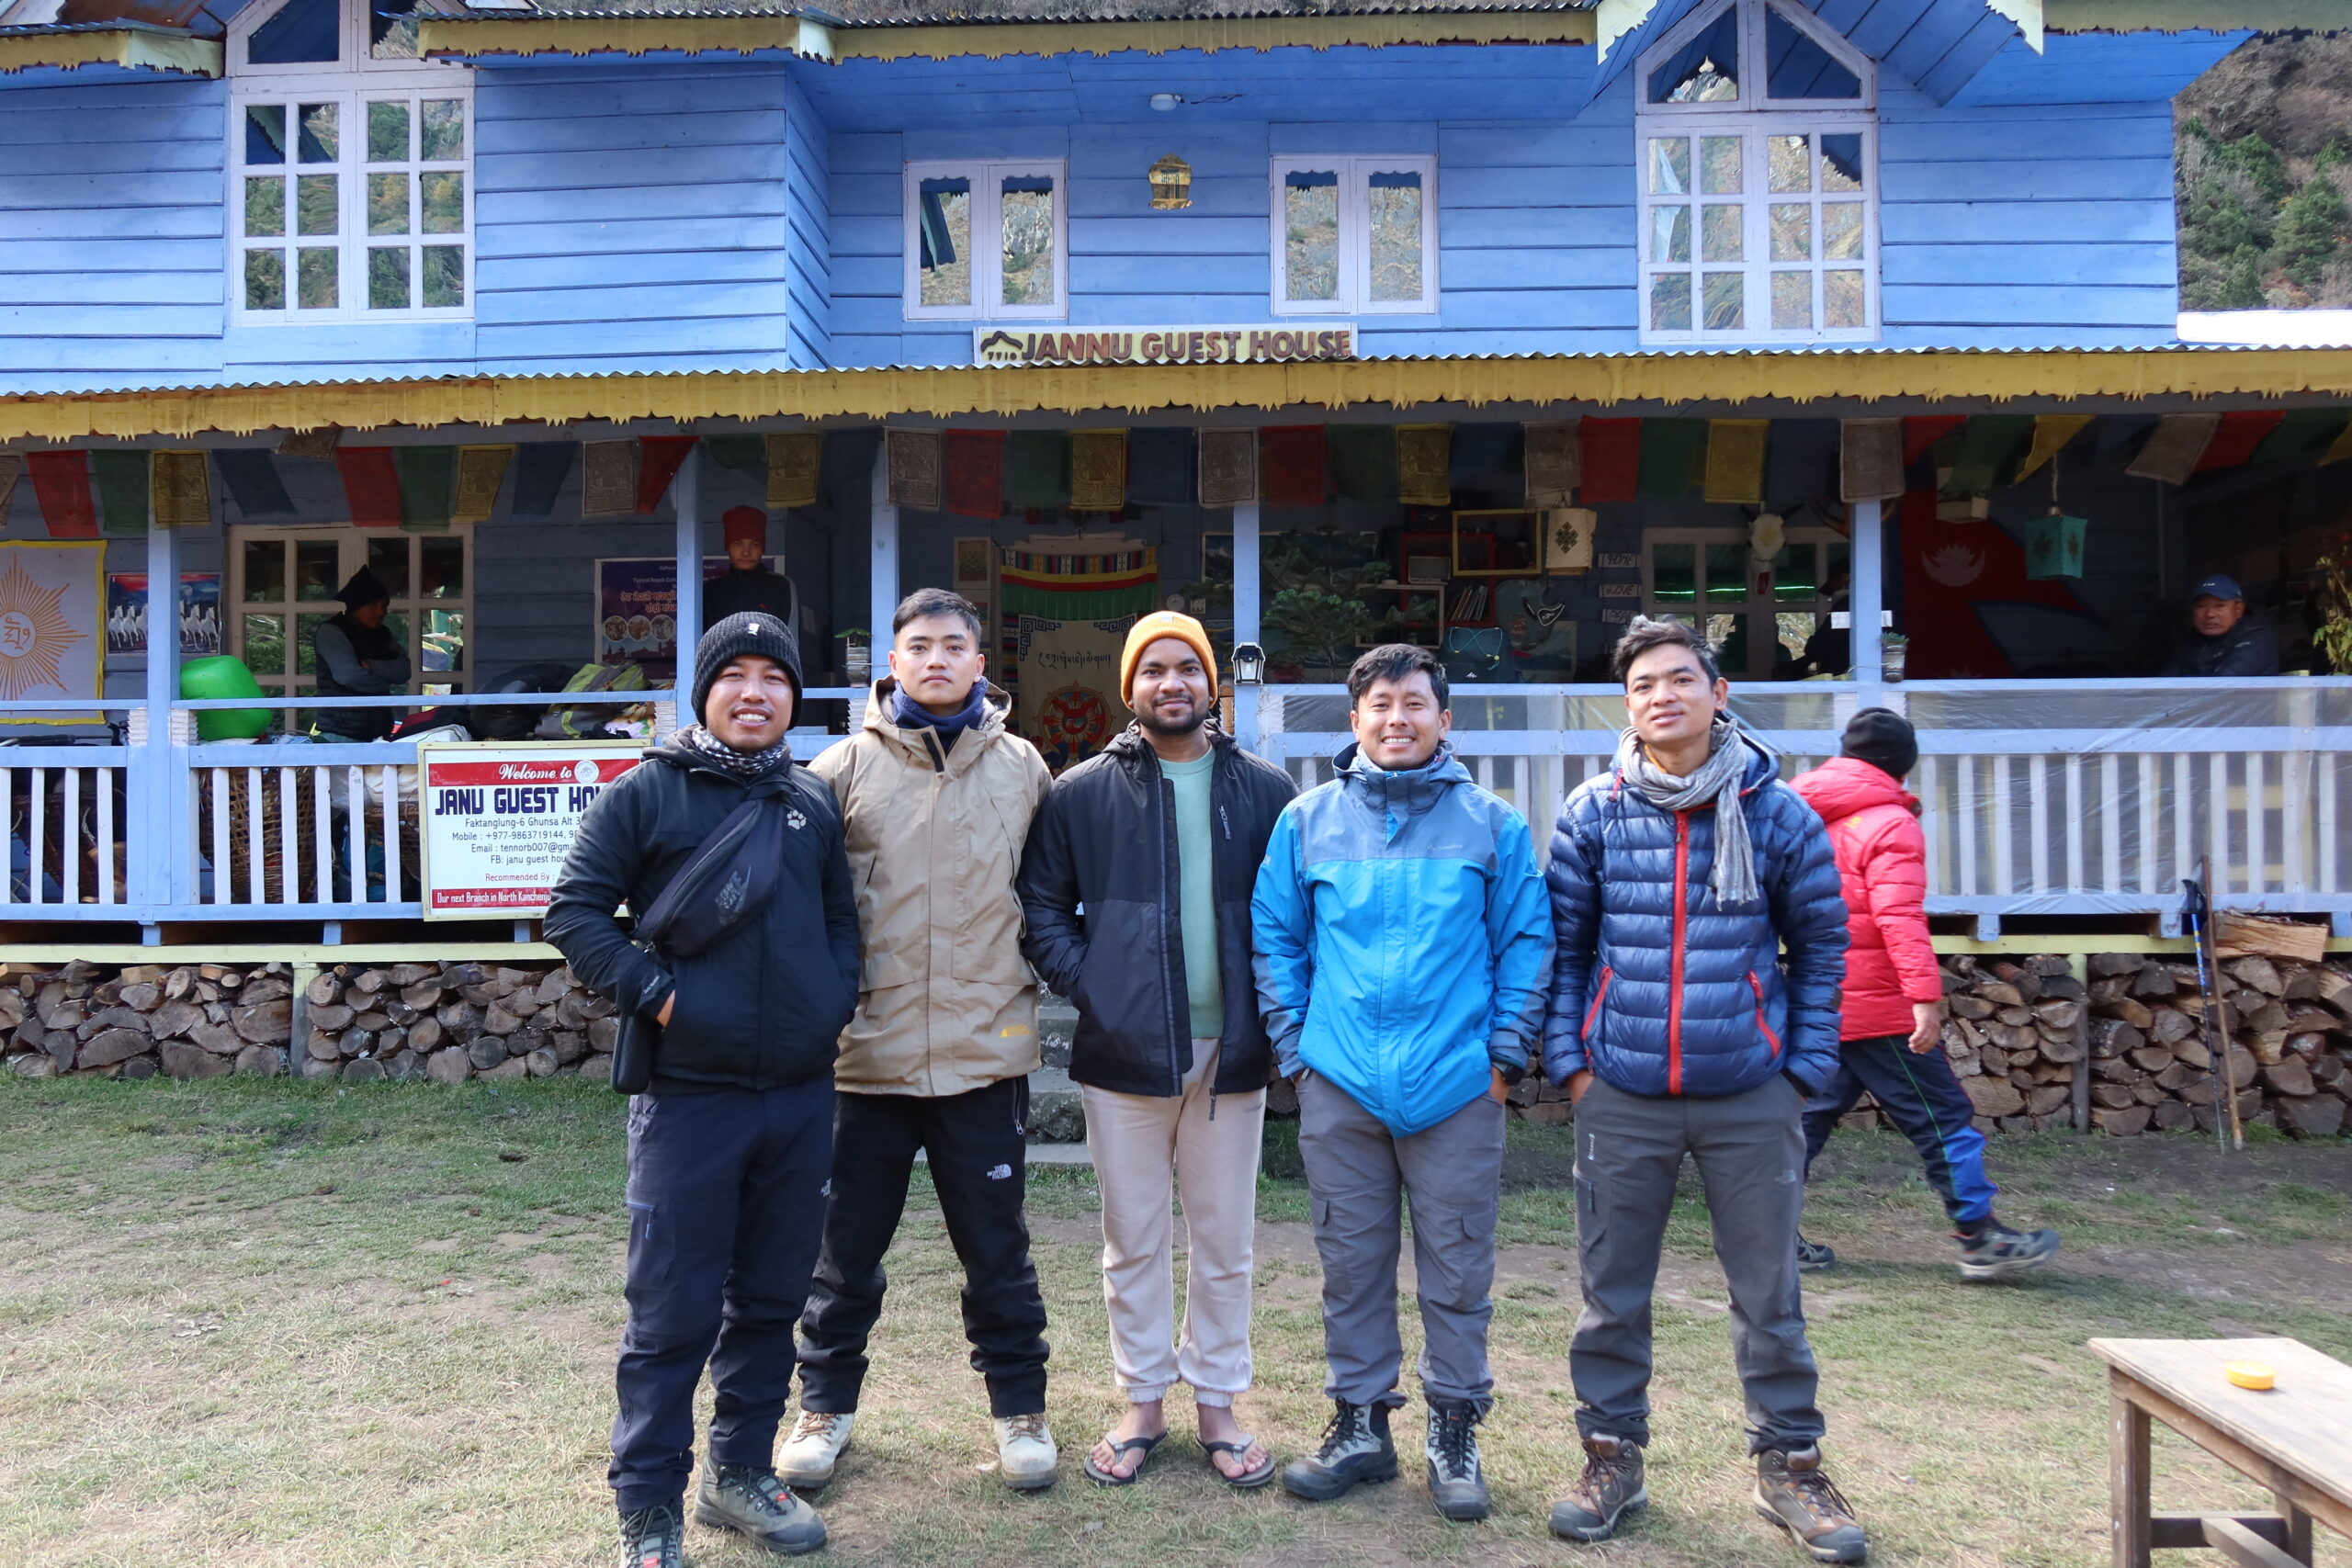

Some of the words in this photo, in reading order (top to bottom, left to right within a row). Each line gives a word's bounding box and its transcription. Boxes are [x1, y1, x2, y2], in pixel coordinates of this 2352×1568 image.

[1022, 333, 1132, 360] JANNU
[1141, 331, 1241, 359] GUEST
[1250, 330, 1351, 358] HOUSE
[499, 763, 556, 780] Welcome
[560, 766, 572, 778] to
[435, 788, 484, 815] JANU
[494, 787, 559, 814] GUEST
[569, 786, 600, 812] HO
[465, 818, 526, 829] Faktanglung-6
[527, 817, 559, 826] Ghunsa
[561, 817, 572, 826] Alt
[452, 832, 478, 840] Mobile
[471, 843, 492, 852] Email
[491, 855, 503, 863] FB:
[506, 854, 524, 865] janu
[526, 855, 548, 865] guest
[551, 854, 566, 863] hou
[485, 872, 538, 882] Recommended
[540, 872, 549, 882] By
[436, 892, 449, 903] Our
[450, 893, 465, 903] next
[466, 891, 490, 903] Branch
[491, 891, 496, 902] in
[498, 891, 516, 902] North
[518, 890, 551, 903] Kanchenju
